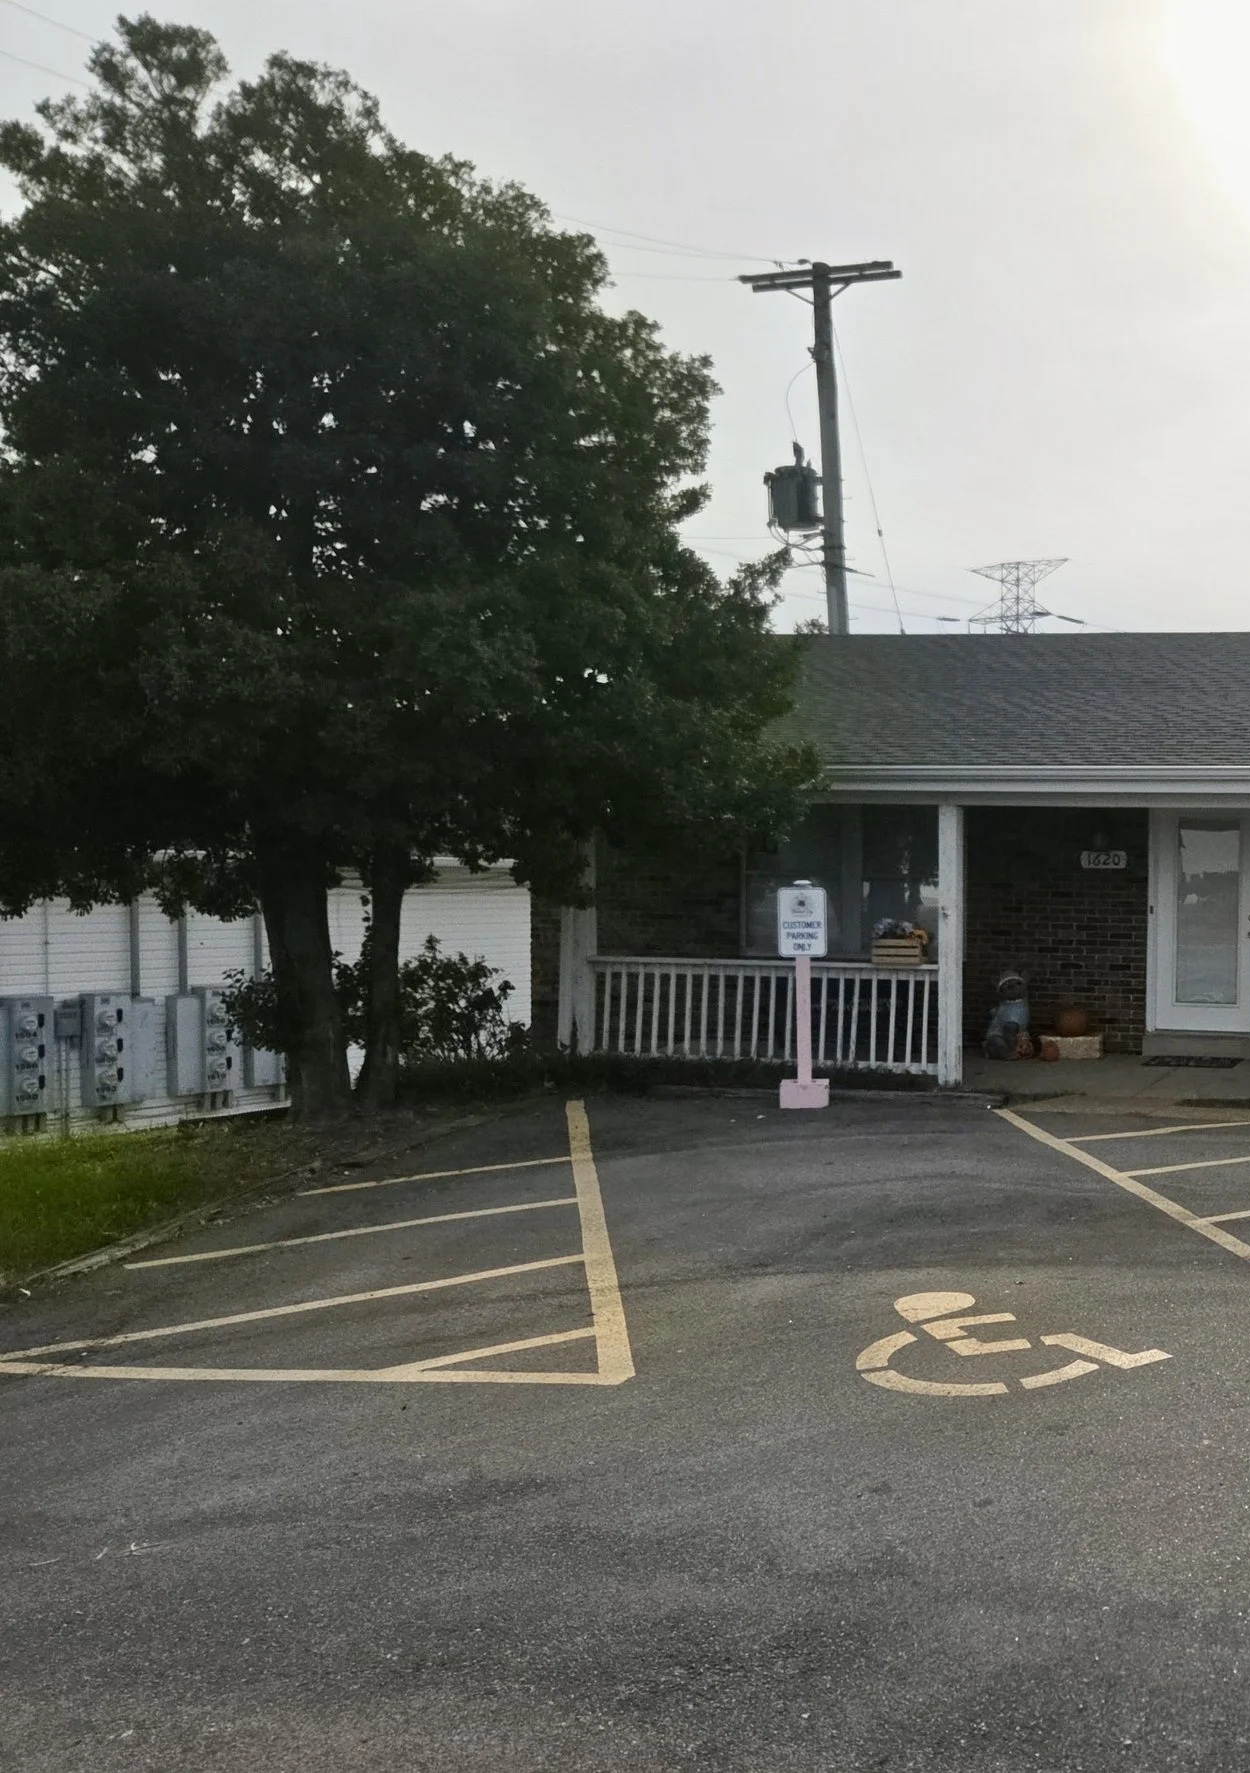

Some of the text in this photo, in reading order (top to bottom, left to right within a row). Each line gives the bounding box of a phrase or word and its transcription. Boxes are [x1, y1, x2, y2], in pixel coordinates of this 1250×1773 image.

[1087, 853, 1121, 867] 1620
[782, 921, 822, 930] CUSTOMER
[786, 931, 819, 940] PARKING
[793, 942, 813, 952] ONLY
